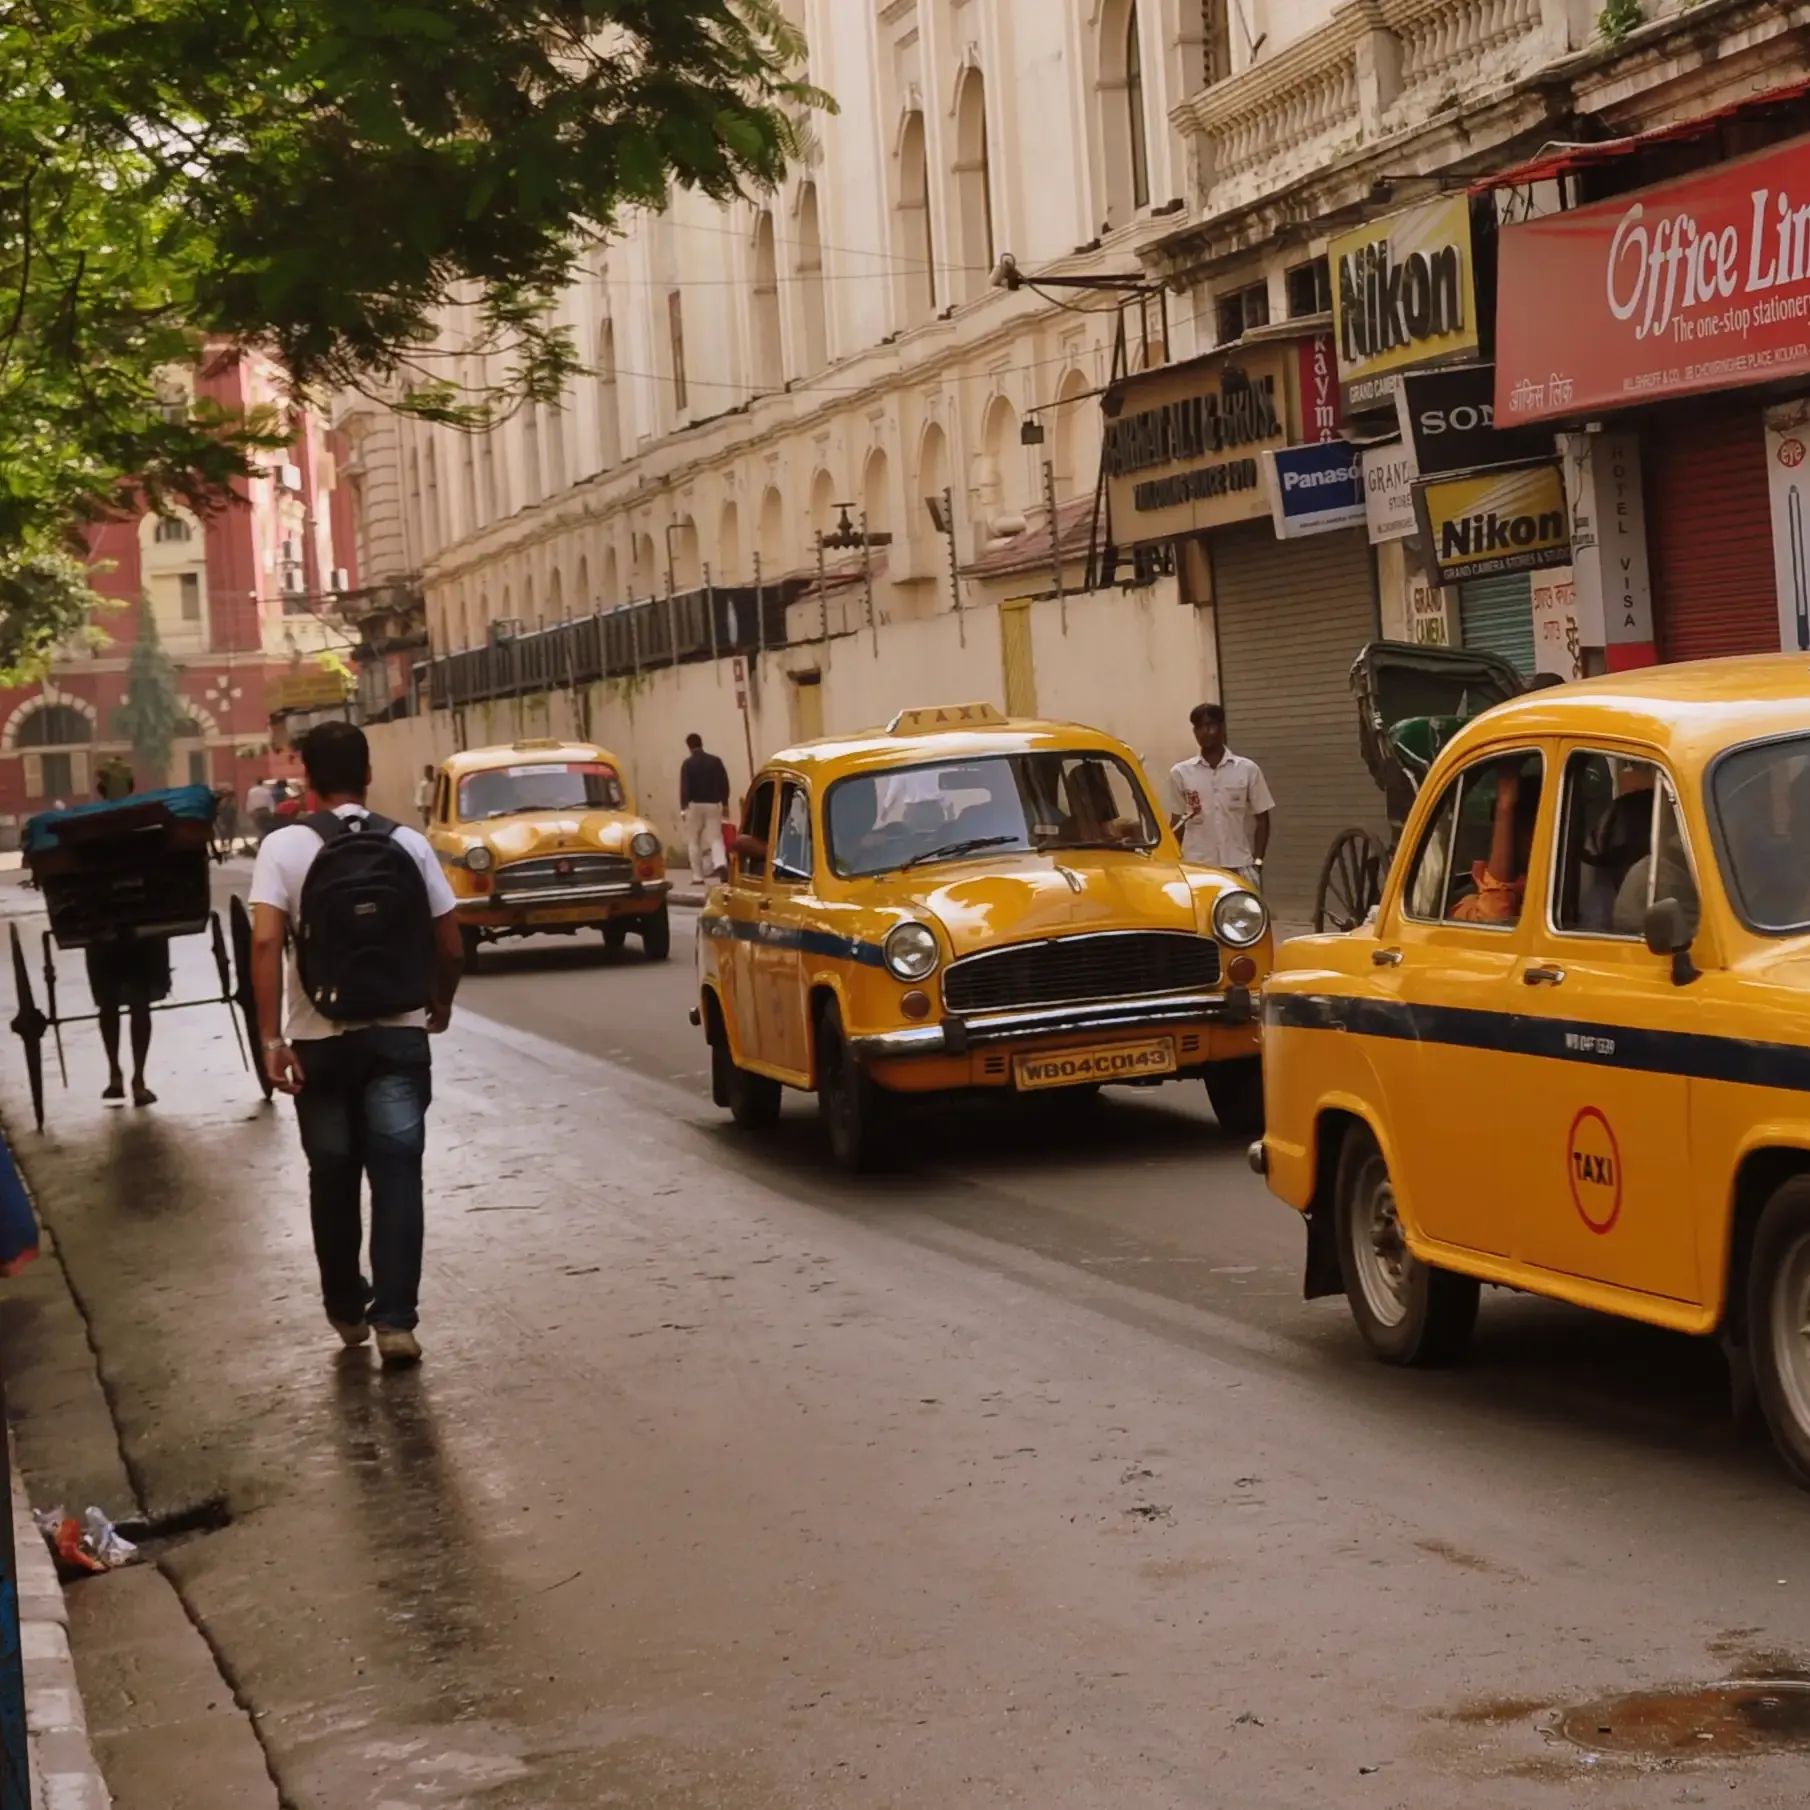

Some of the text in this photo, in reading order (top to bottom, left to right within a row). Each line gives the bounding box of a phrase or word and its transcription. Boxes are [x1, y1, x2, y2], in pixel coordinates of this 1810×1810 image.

[1606, 202, 1739, 340] Office
[1339, 237, 1464, 363] Nikon
[1671, 315, 1694, 344] The
[1696, 309, 1751, 340] one-stop
[1441, 509, 1564, 561] Nikon
[1611, 446, 1636, 628] HOTEL VISA
[1443, 564, 1472, 581] GRAND
[907, 703, 988, 726] TAXI
[1025, 1050, 1167, 1081] WB04C0143
[1573, 1151, 1614, 1187] TAXI
